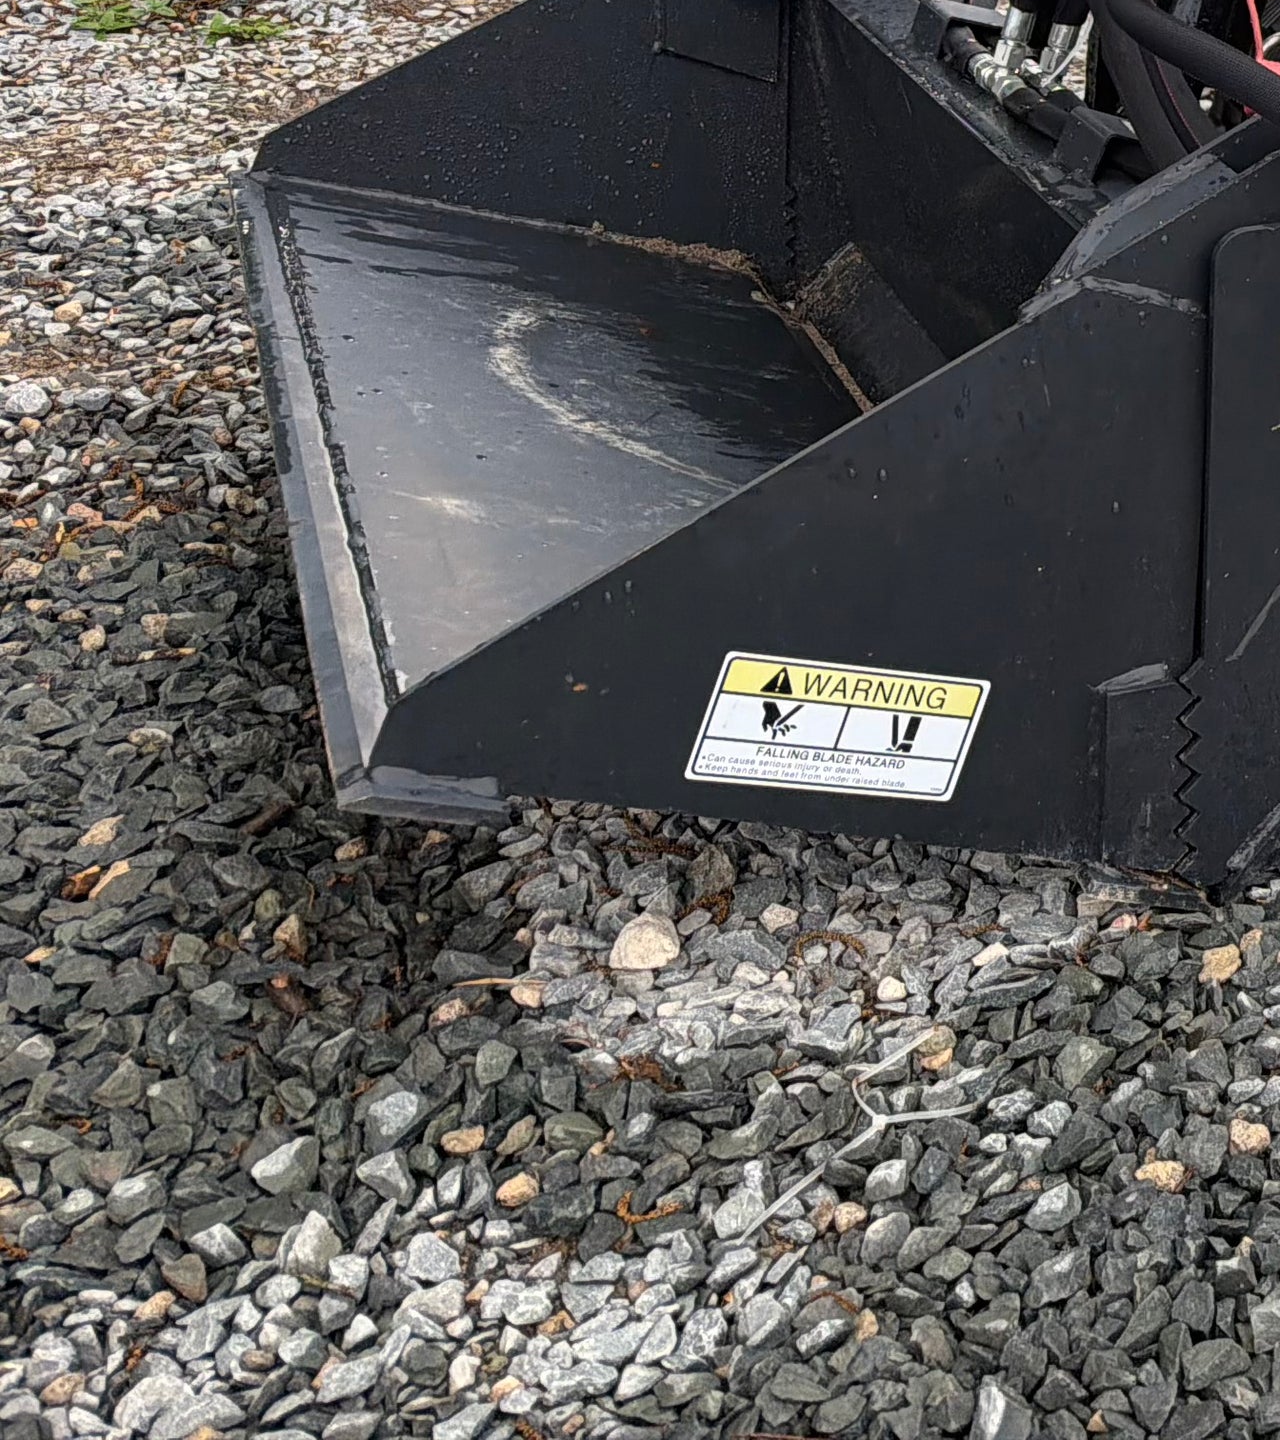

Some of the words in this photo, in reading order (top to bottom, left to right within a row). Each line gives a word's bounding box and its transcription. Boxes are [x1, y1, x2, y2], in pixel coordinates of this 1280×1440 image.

[803, 672, 948, 709] WARNING
[707, 753, 726, 763] Can
[728, 757, 755, 765] cause
[758, 759, 792, 768] serious
[794, 762, 820, 772] injury
[755, 746, 809, 761] FALLING
[812, 751, 854, 765] BLADE
[855, 756, 905, 769] HAZARD
[704, 764, 728, 773] Keep
[730, 766, 758, 775] hands
[761, 768, 778, 777] and
[781, 769, 798, 779] feet
[800, 771, 821, 781] from
[824, 774, 850, 783] under
[852, 776, 879, 785] raised
